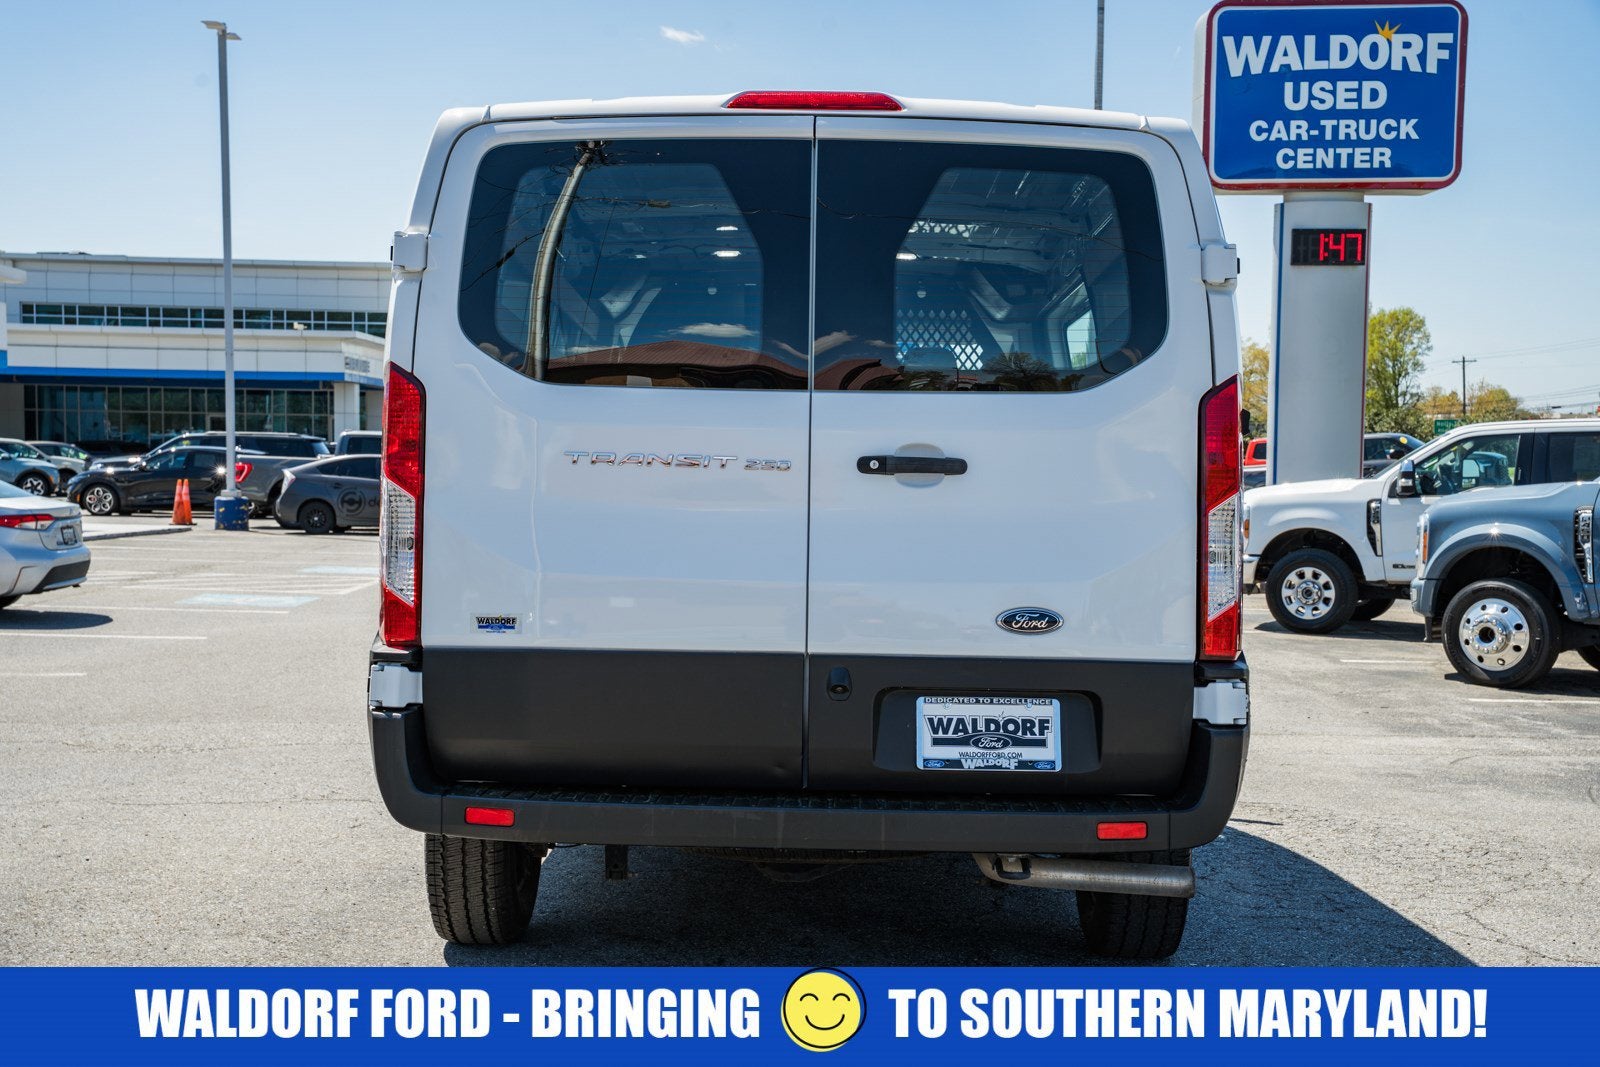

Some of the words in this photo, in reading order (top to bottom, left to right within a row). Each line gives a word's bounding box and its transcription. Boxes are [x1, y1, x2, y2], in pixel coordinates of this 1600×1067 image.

[1222, 32, 1454, 77] WALDORF
[1284, 80, 1388, 111] USED
[1249, 118, 1420, 142] CAR-TRUCK
[1276, 147, 1392, 170] CENTER
[1319, 233, 1363, 262] 1:47
[564, 450, 738, 469] TRANSIT
[744, 458, 792, 471] 250
[476, 616, 517, 625] WALDORF
[1012, 612, 1049, 628] Ford
[926, 717, 1051, 736] WALDORF
[978, 737, 1004, 748] Ford
[958, 751, 1023, 759] WALDORFFORD.COM
[960, 758, 1019, 769] WALDORF
